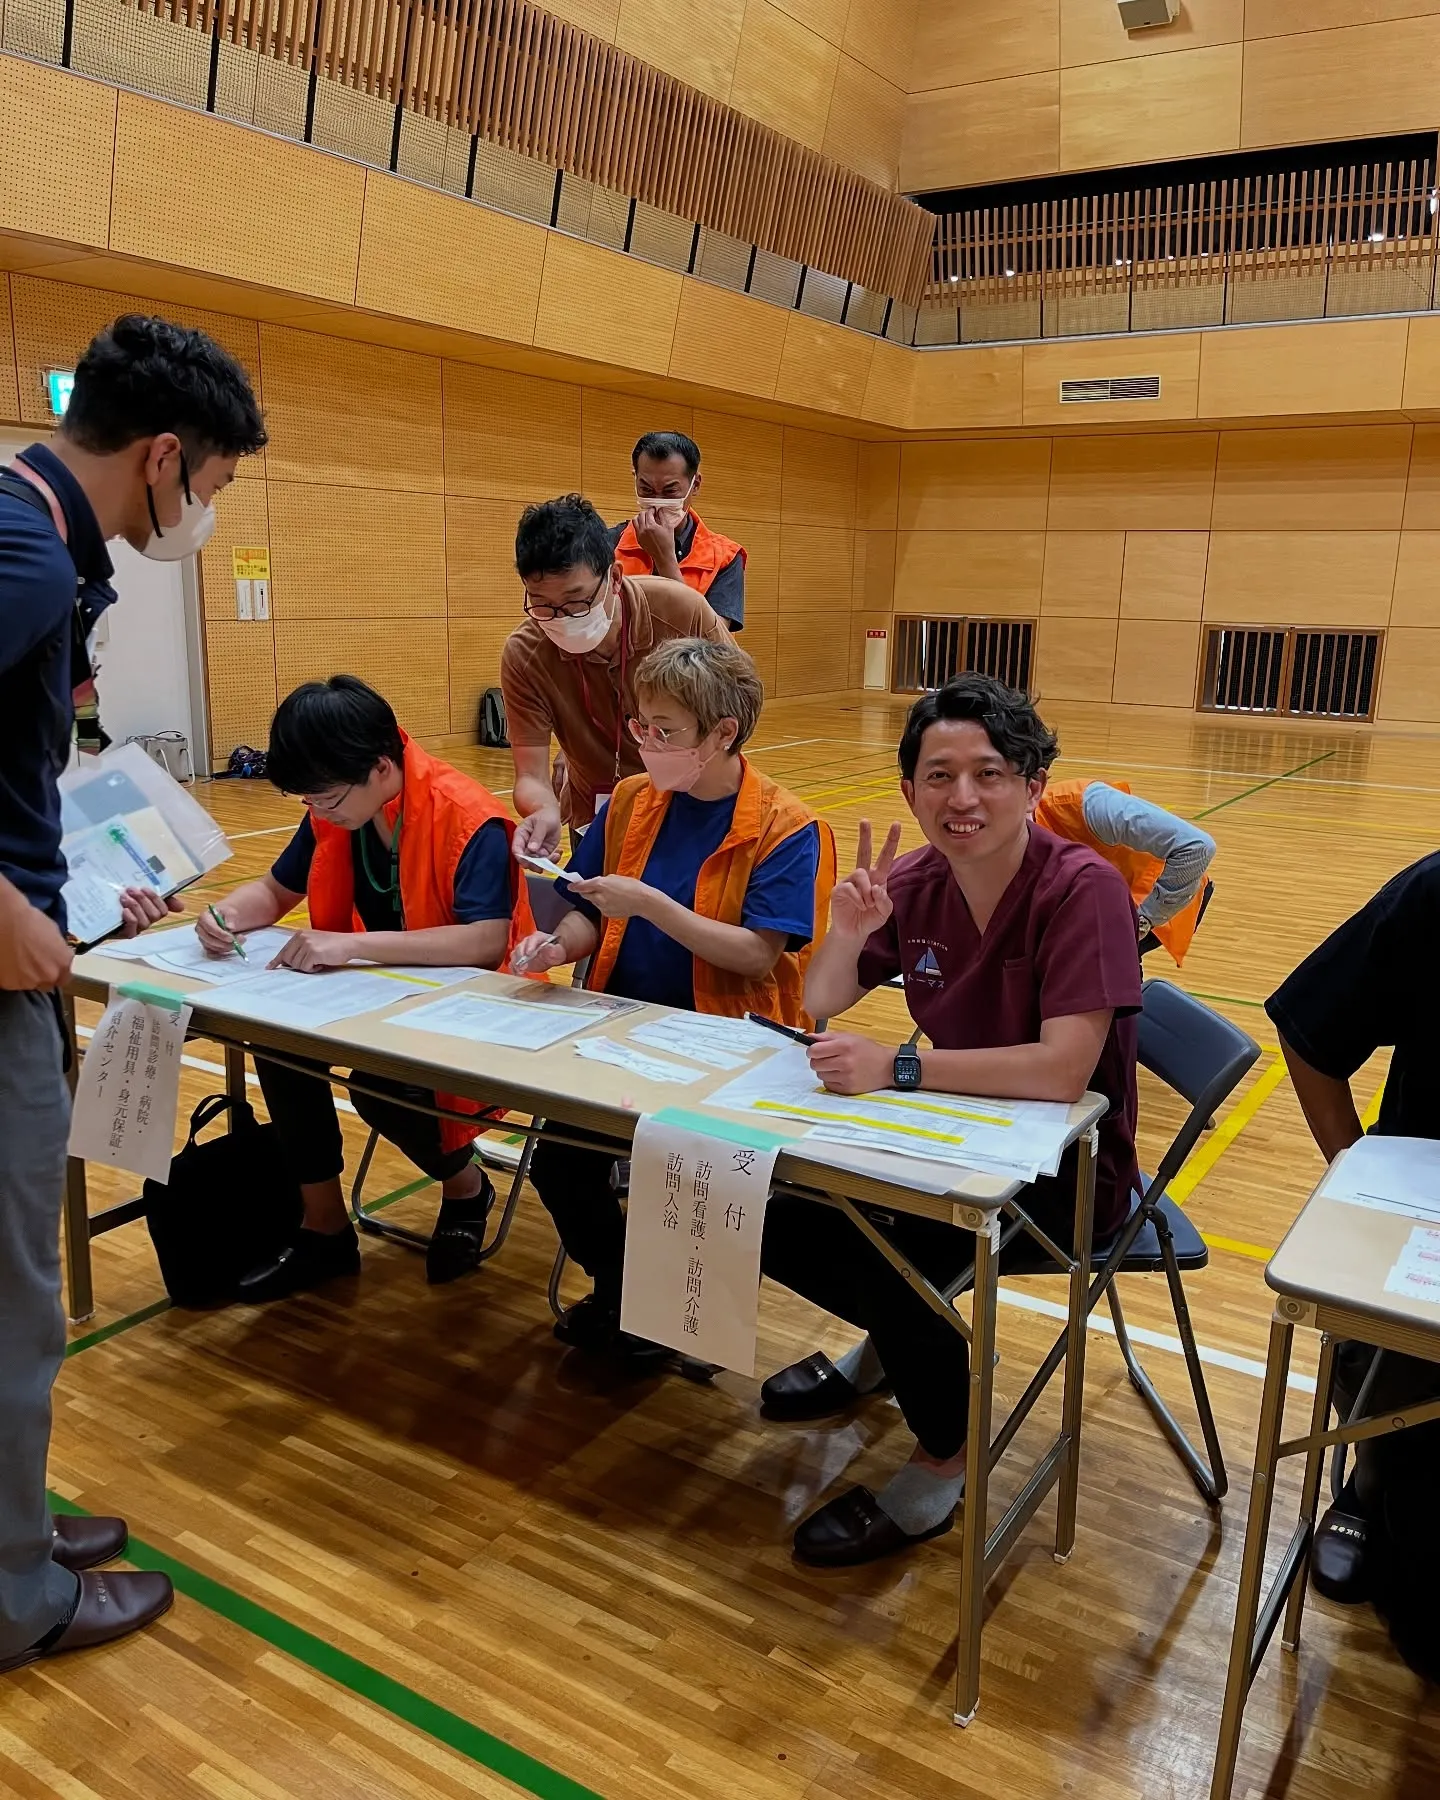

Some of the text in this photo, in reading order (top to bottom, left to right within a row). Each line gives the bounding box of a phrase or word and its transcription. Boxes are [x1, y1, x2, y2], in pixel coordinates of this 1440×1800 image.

[907, 973, 945, 988] トーマス
[662, 1152, 684, 1231] 訪問入浴
[723, 1149, 756, 1232] 受付
[683, 1159, 713, 1337] 訪問看護・訪問介護
